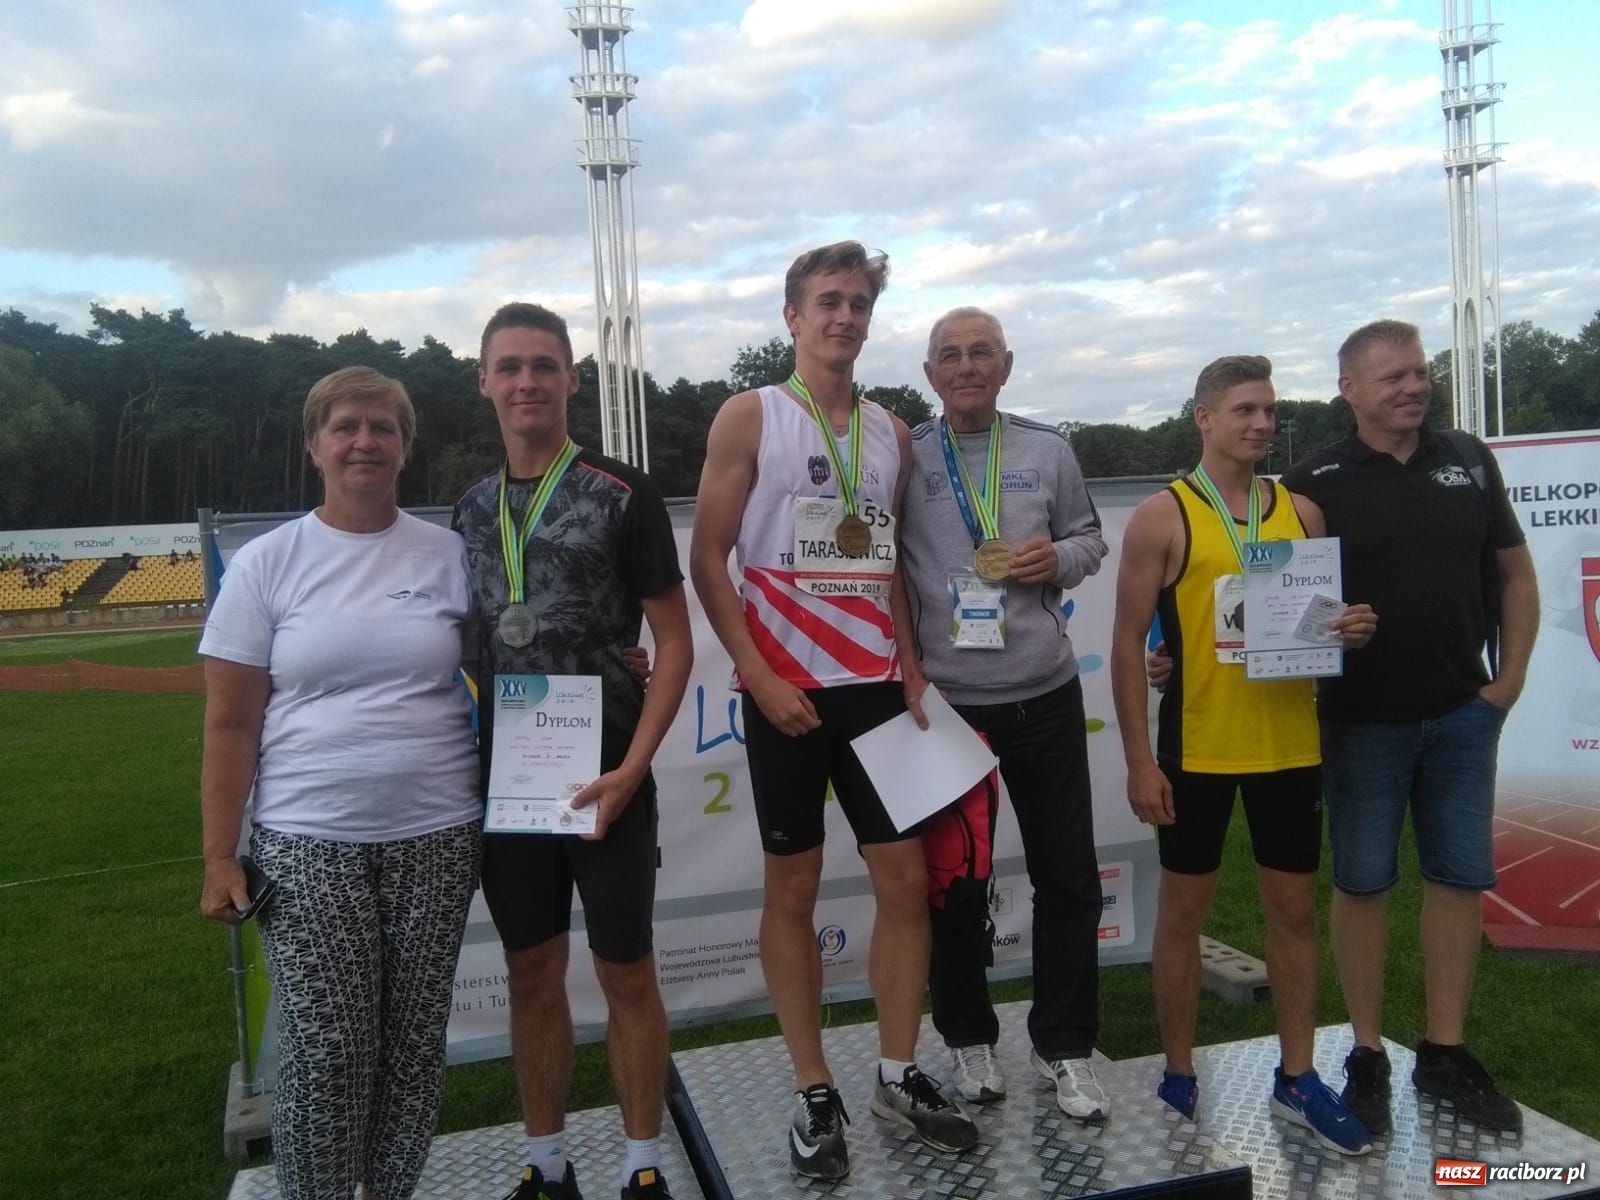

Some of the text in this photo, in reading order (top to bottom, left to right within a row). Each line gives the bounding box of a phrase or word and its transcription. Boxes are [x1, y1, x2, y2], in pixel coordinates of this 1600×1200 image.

[1000, 480, 1033, 490] ORUŃ
[1506, 482, 1600, 503] IELKOP
[857, 504, 890, 528] 55
[1531, 508, 1598, 527] LEKKI
[799, 540, 893, 561] TARASICZ
[811, 581, 858, 594] POZNAŃ
[1282, 573, 1333, 587] DYPLOM
[535, 712, 592, 728] DYPLOM
[659, 947, 697, 958] Patronat
[699, 941, 743, 953] Honorowy
[660, 958, 721, 972] Województwa
[697, 971, 720, 982] Anny
[721, 966, 746, 977] Polak
